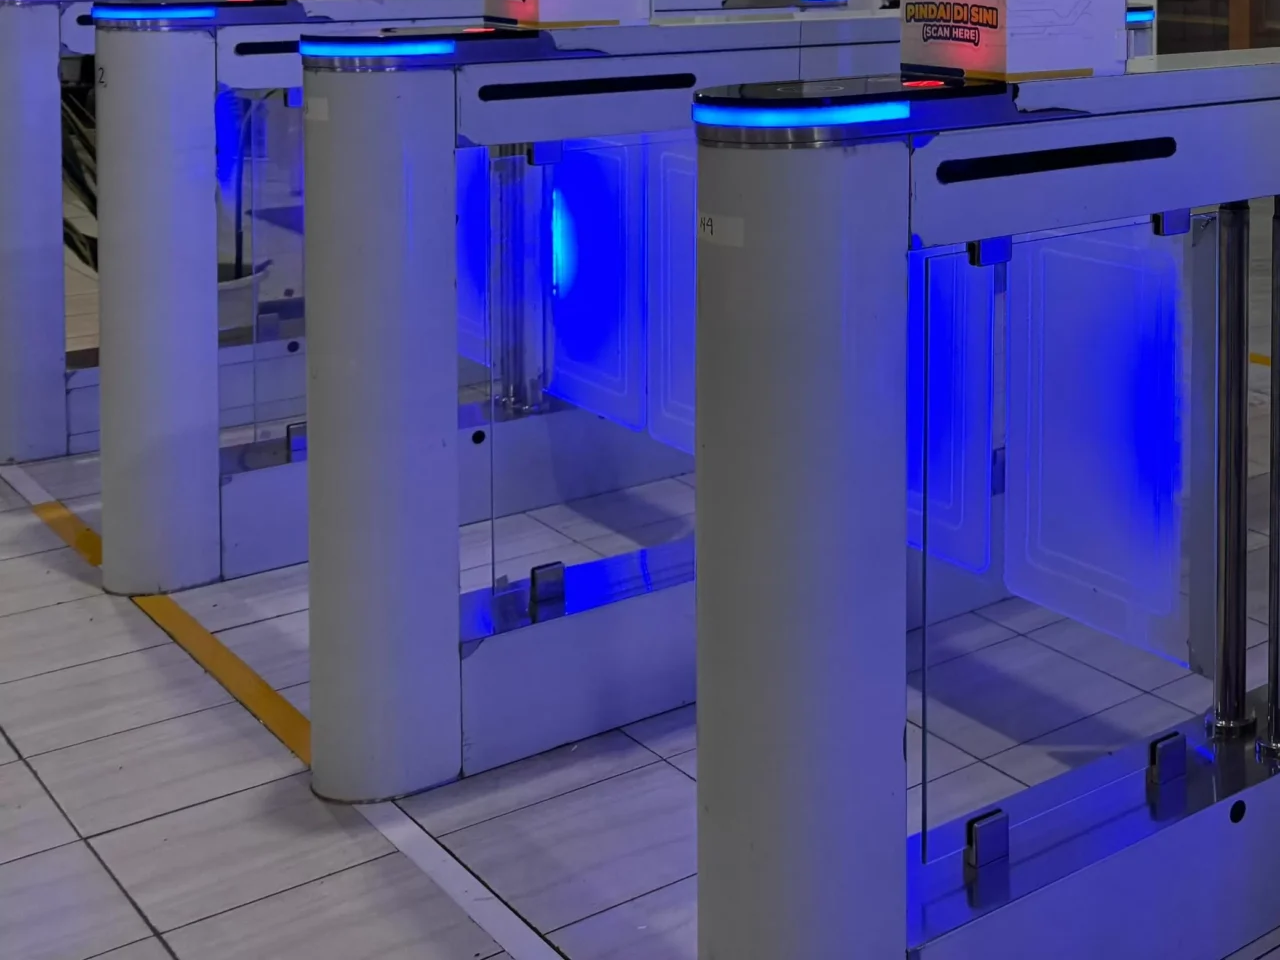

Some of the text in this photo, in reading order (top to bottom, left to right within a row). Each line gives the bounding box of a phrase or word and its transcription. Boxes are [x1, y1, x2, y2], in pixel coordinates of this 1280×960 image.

[906, 3, 999, 28] PINDAI DI SINI
[922, 26, 980, 45] (SCAN HERE)
